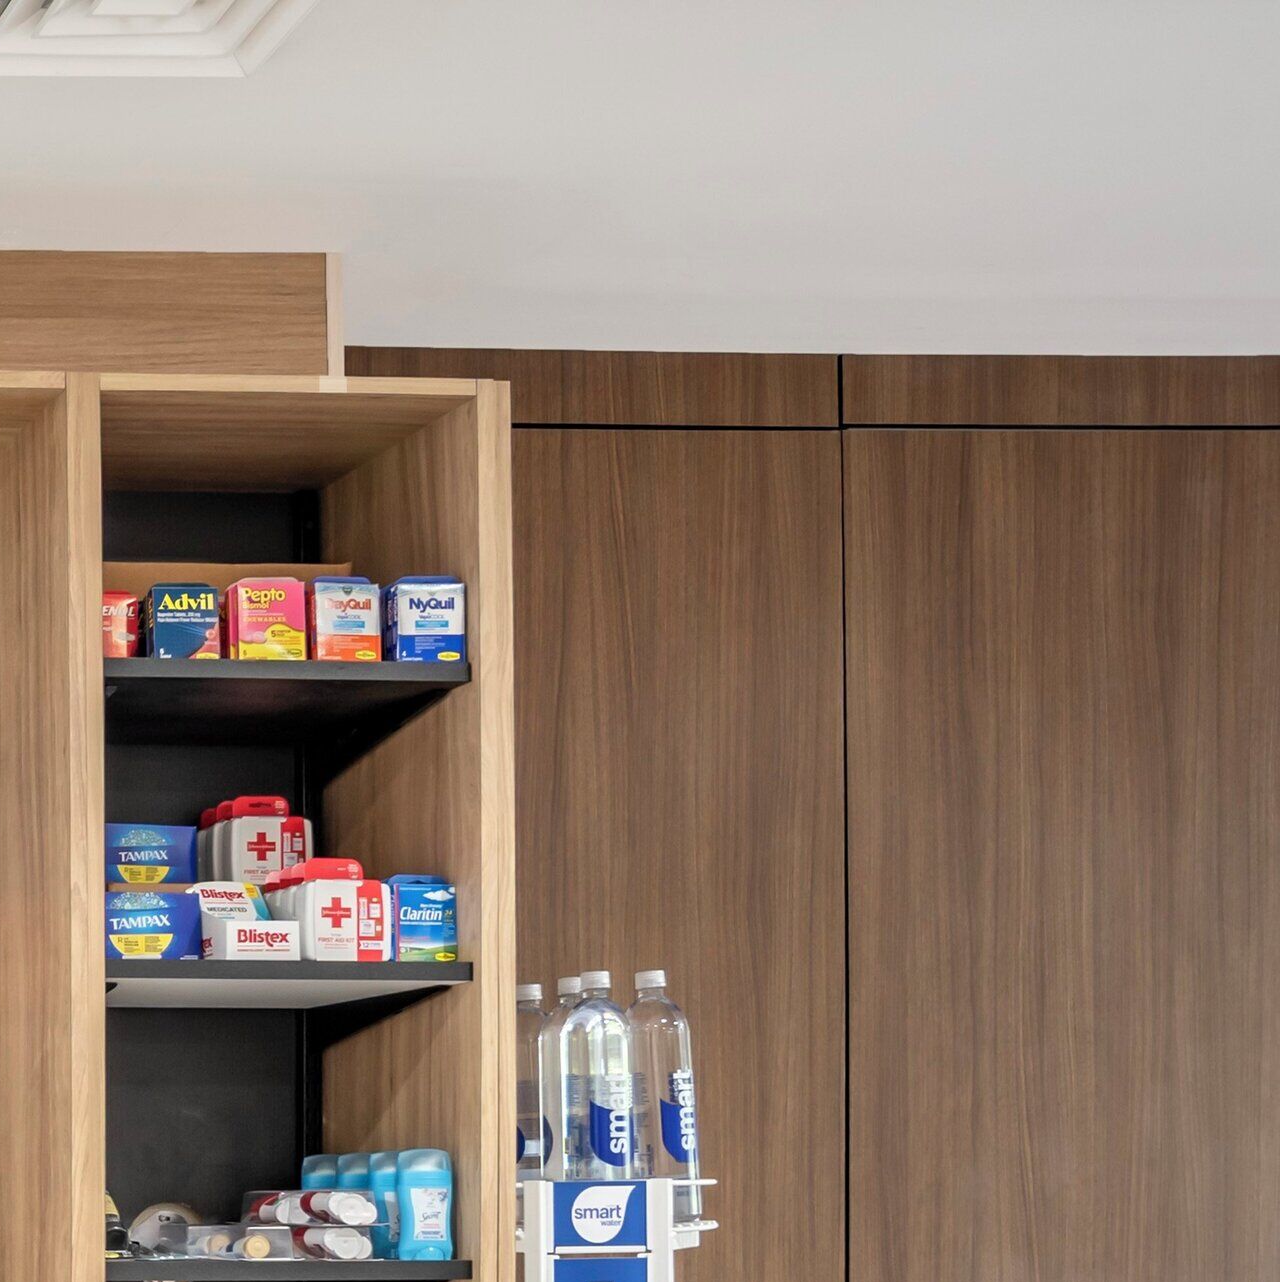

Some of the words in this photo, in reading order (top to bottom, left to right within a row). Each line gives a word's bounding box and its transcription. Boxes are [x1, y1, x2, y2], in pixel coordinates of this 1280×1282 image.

[158, 593, 214, 611] Advil
[241, 587, 286, 602] Pepto
[242, 602, 270, 610] Bismol
[325, 598, 371, 612] DayQuil
[409, 597, 455, 612] NyQuil
[118, 849, 168, 862] TAMPAX
[200, 888, 245, 902] Blistex
[206, 906, 248, 914] MEDICATED
[400, 906, 442, 921] Claritin
[109, 914, 171, 930] TAMPAX
[237, 929, 290, 947] Blistex
[608, 1074, 631, 1154] smart
[574, 1204, 622, 1220] smart
